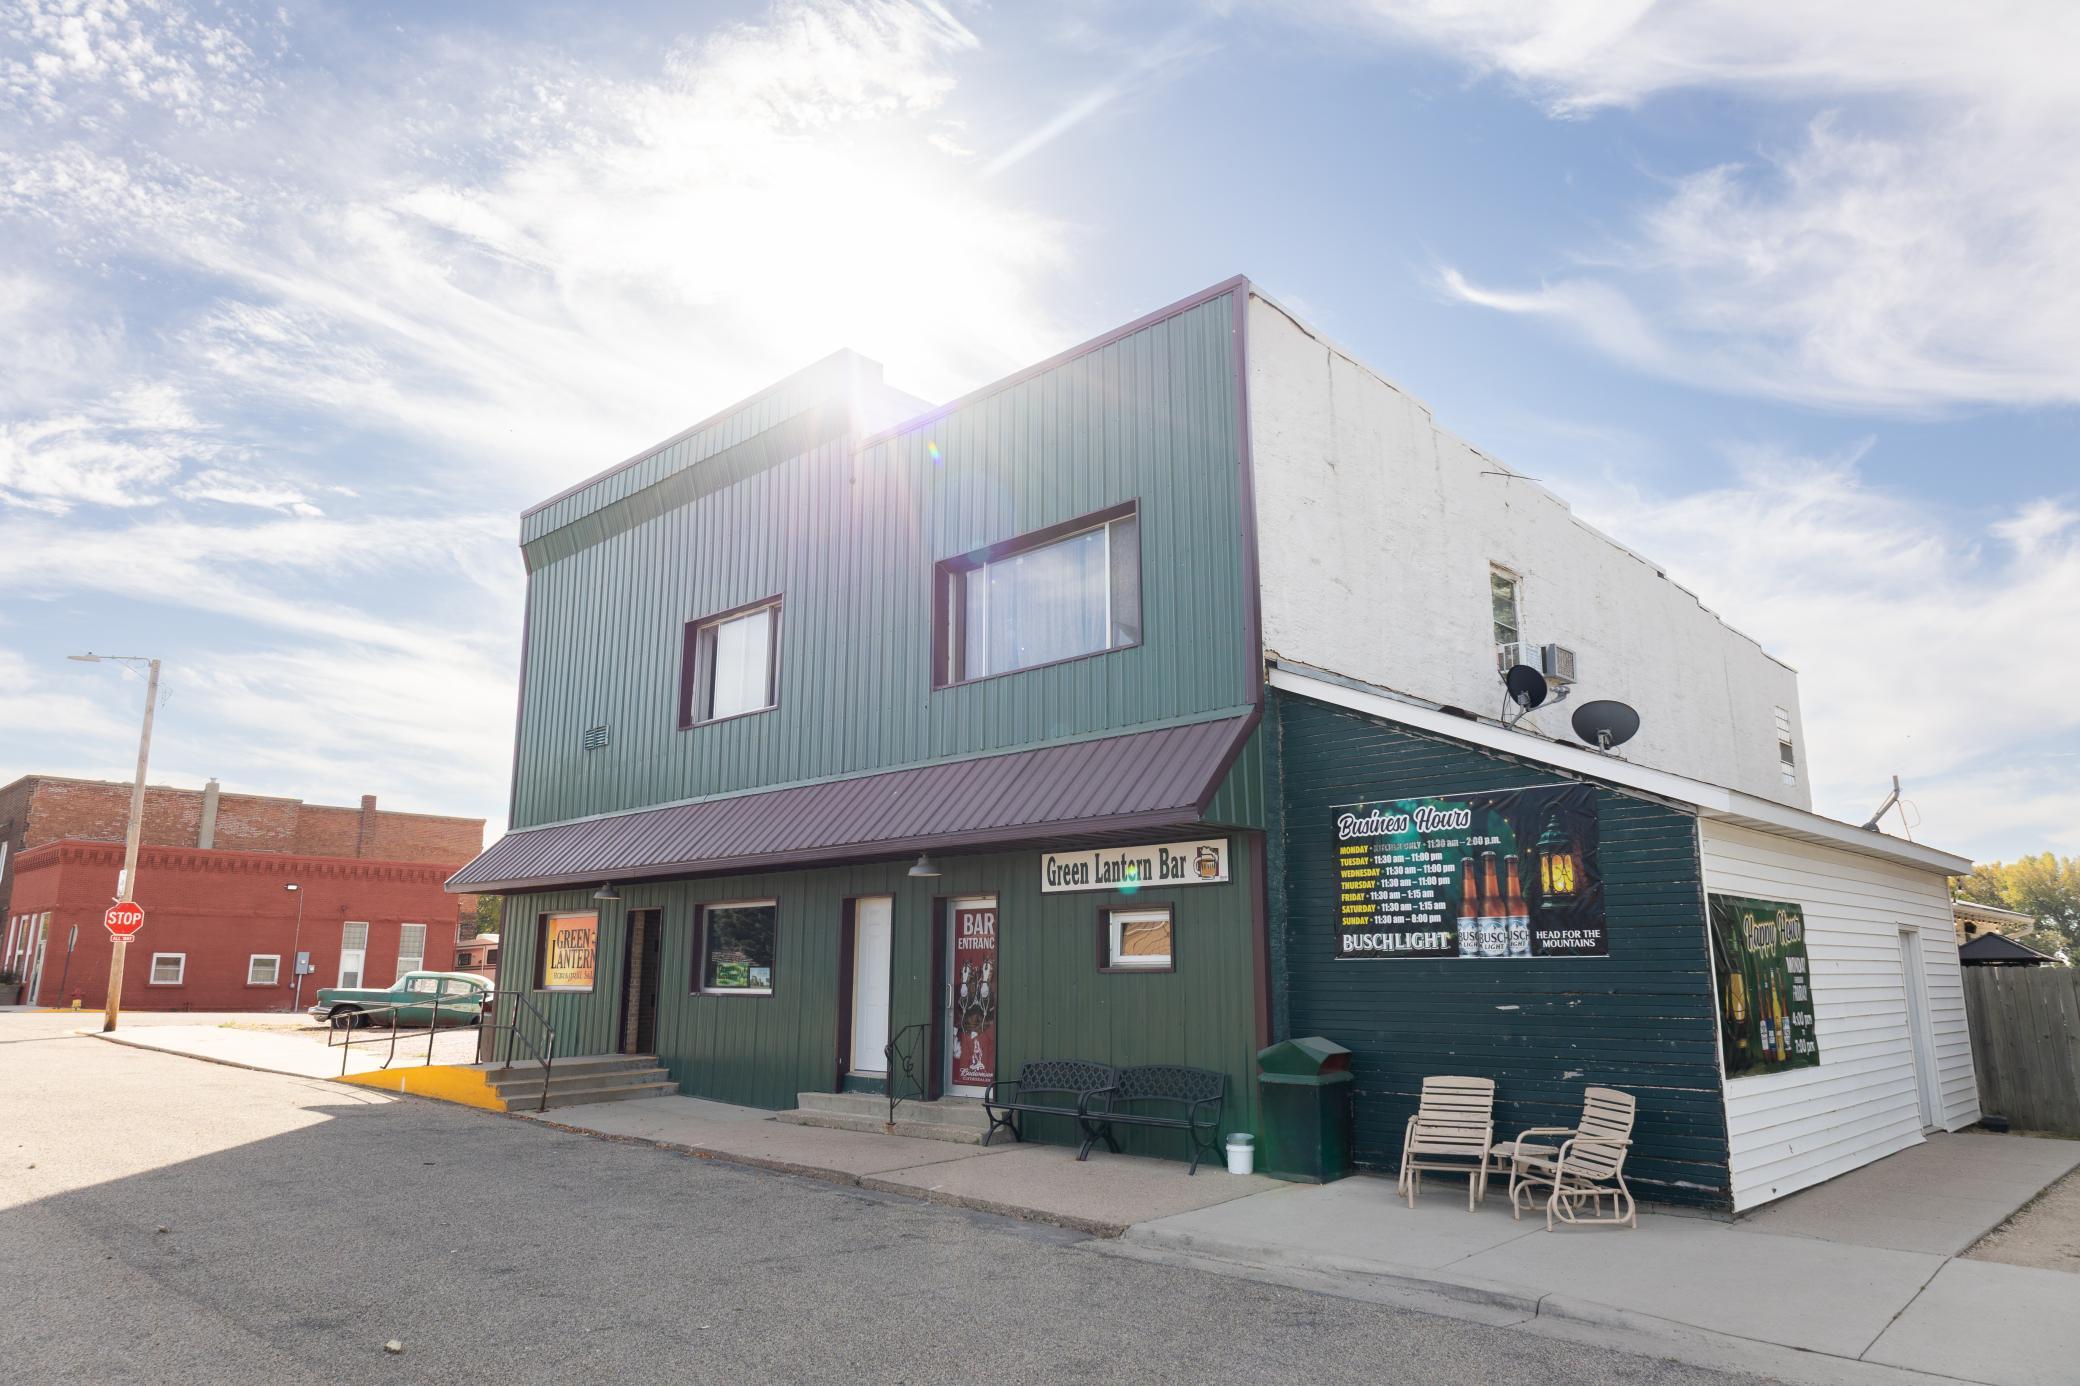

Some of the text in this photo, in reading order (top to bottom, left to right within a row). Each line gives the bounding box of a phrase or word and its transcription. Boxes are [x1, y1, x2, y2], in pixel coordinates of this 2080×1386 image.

[1338, 806, 1471, 840] Business Hours
[1340, 845, 1368, 854] MONDAY
[1427, 839, 1446, 848] 11:30
[1447, 839, 1459, 847] am
[1340, 852, 1442, 866] TUESDAY 11:30 am 11:00 pm
[1047, 848, 1186, 886] Green Lantern Bar
[1341, 864, 1455, 878] WEDNESDAY 11:30 am 11:00 pm
[1341, 881, 1375, 890] THURSDAY
[1381, 878, 1398, 888] 11:30
[1419, 876, 1437, 886] 11:00
[1438, 877, 1450, 885] pm
[1341, 890, 1434, 901] FRIDAY 11:30 am 1:15 am
[1342, 902, 1446, 913] SATURDAY 11:30 am 1:15 am
[108, 912, 141, 925] STOP
[964, 913, 995, 935] BAR
[1342, 917, 1368, 925] SUNDAY
[1374, 915, 1392, 924] 11:30
[1393, 915, 1404, 923] am
[1429, 914, 1441, 923] pm
[557, 929, 591, 948] GREEN
[1459, 931, 1479, 942] BUSC
[1536, 930, 1600, 939] HEAD FOR THE
[1743, 910, 1801, 959] Happy Hour
[958, 937, 995, 949] ENTRANC
[1542, 939, 1595, 947] MOUNTAINS
[551, 940, 596, 969] LANTERN
